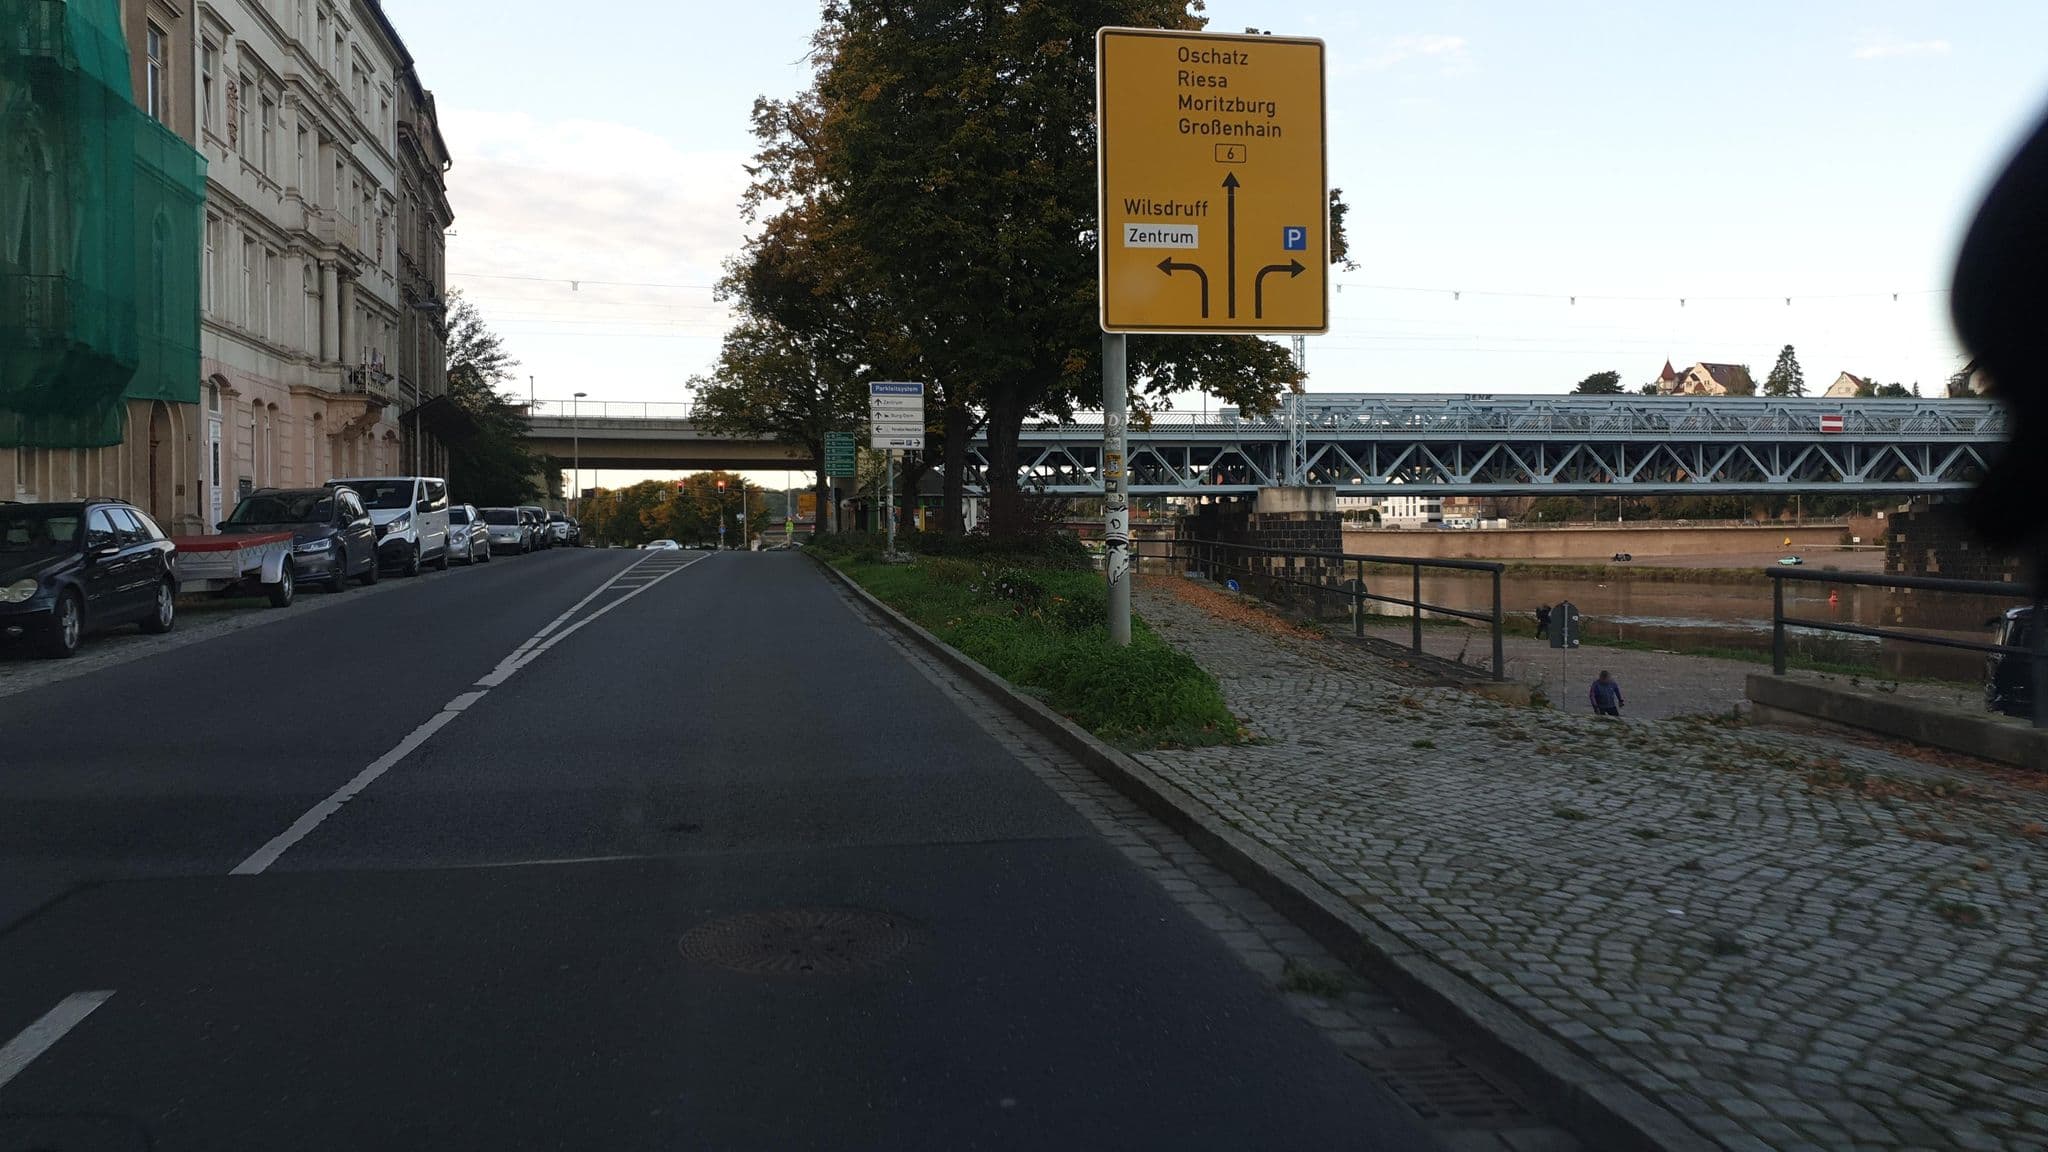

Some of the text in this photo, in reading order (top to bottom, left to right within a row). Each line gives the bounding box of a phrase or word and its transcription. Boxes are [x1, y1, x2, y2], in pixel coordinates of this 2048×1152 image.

[1178, 46, 1249, 66] Oschatz
[1178, 69, 1228, 88] Riesa
[1178, 94, 1276, 118] Moritzburg
[1178, 118, 1282, 138] Großenhain
[1227, 147, 1235, 160] 6
[1124, 198, 1209, 217] Wilsdruff
[1129, 228, 1194, 244] Zentrum
[1288, 228, 1302, 249] P
[875, 385, 919, 393] Parkleitsystem
